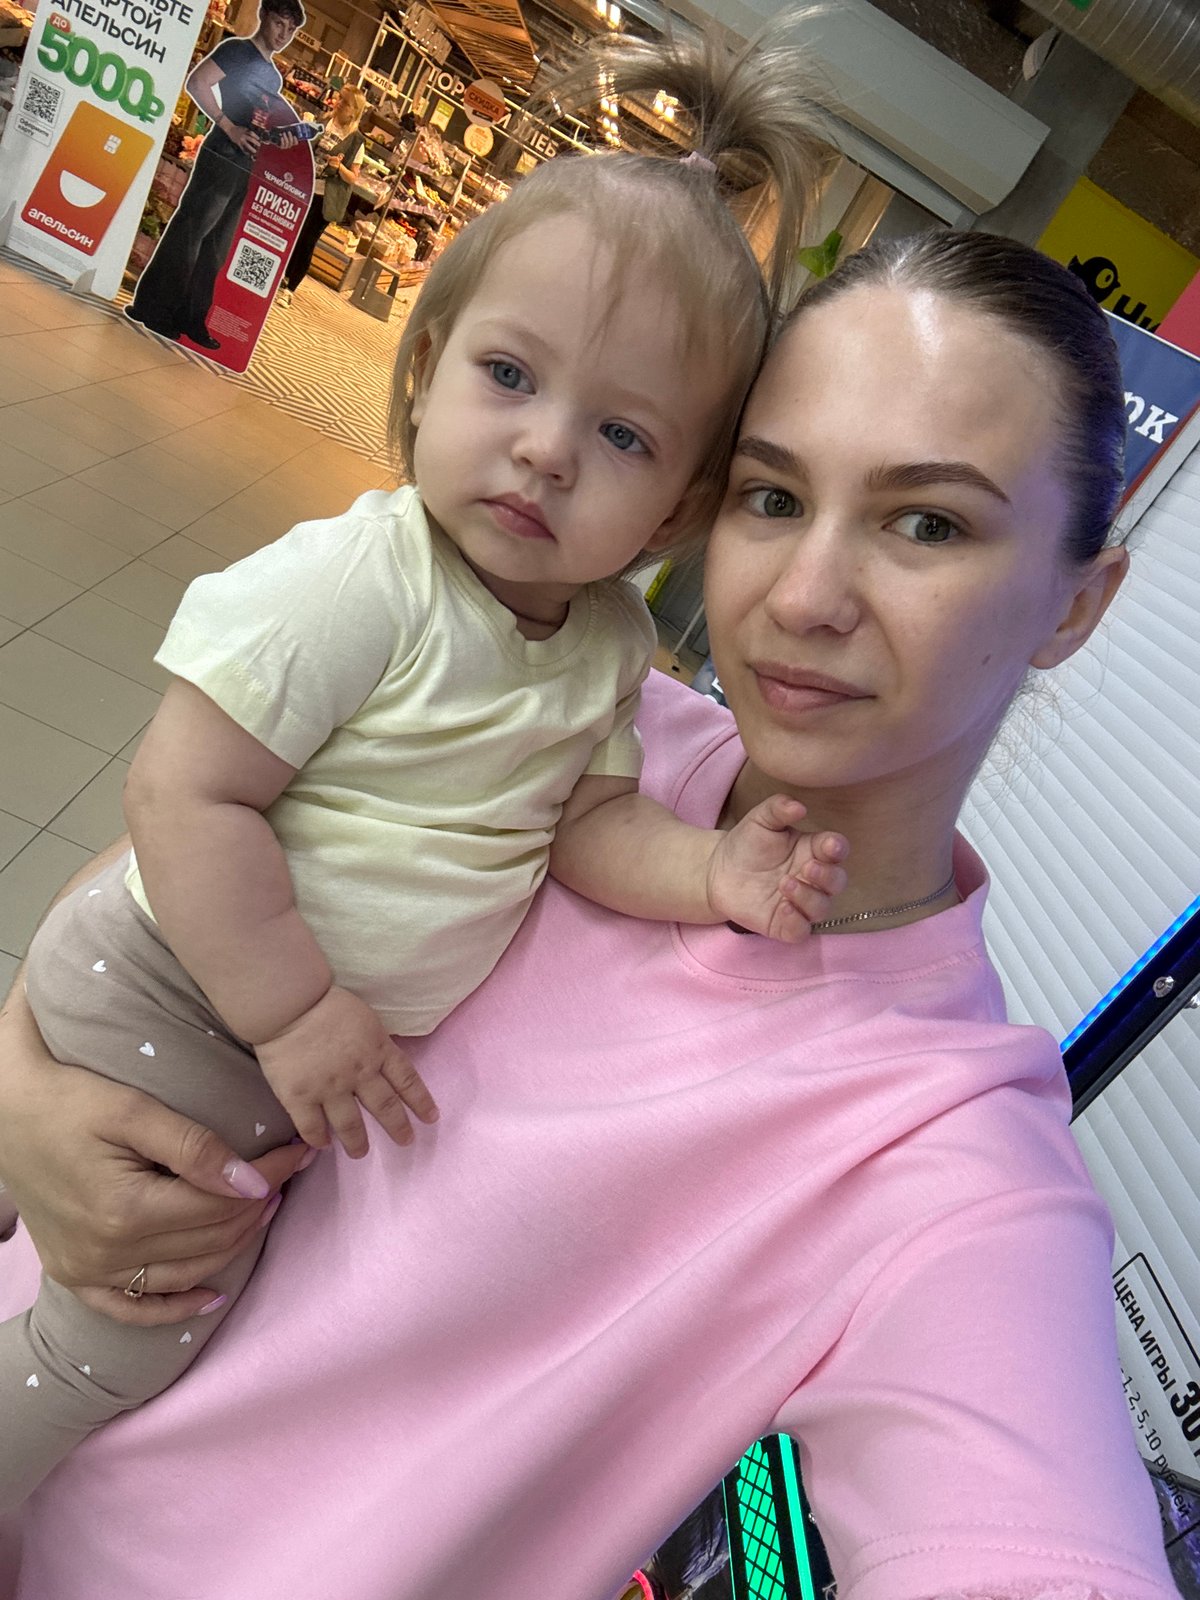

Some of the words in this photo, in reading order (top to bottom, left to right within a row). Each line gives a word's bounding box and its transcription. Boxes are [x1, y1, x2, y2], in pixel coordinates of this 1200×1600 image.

[50, 0, 167, 63] АПЕЛЬСИН
[251, 202, 264, 213] БЕЗ
[262, 209, 295, 231] ОСТАНОВКИ
[254, 185, 302, 223] ПРИЗЫ
[27, 207, 94, 248] апельсин
[1113, 1276, 1146, 1333] ЦЕНА
[1139, 1329, 1177, 1392] ИГРЫ
[1128, 1391, 1141, 1411] 2,
[1136, 1408, 1150, 1430] 5,
[1145, 1428, 1162, 1451] 10
[1153, 1453, 1190, 1519] рублей
